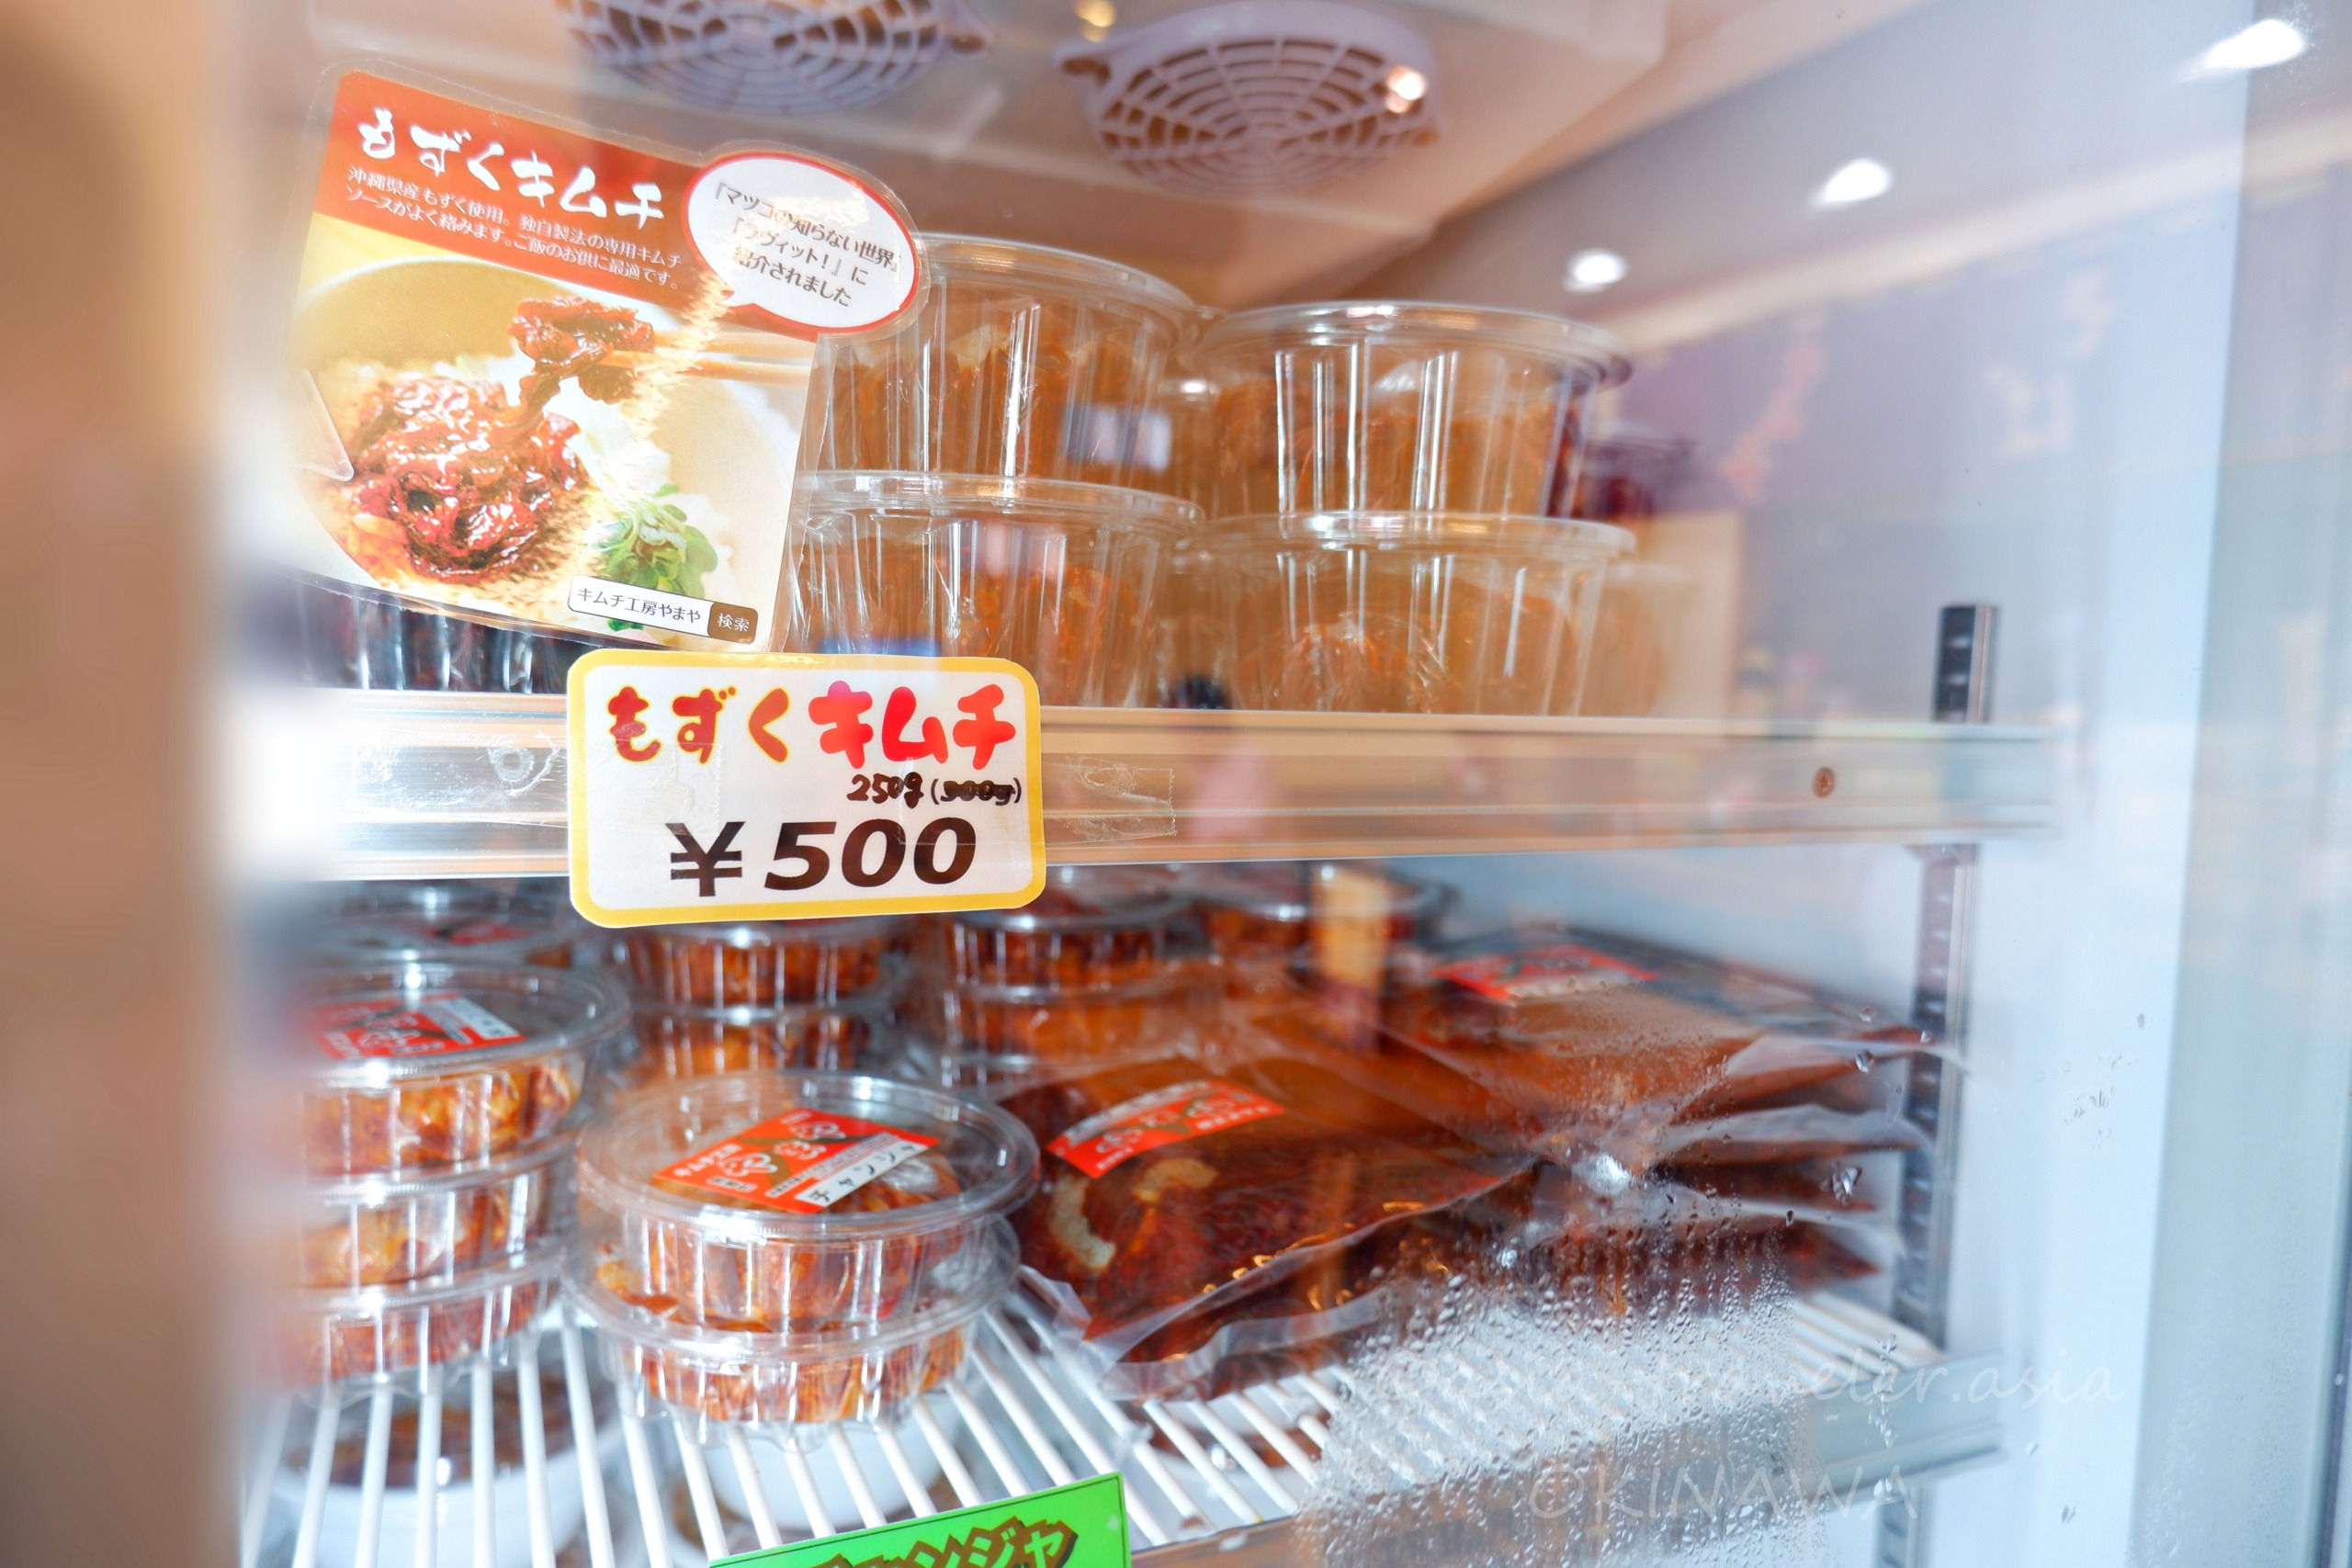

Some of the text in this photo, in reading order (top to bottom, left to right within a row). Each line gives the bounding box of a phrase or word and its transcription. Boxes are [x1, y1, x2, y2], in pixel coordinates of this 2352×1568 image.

[359, 108, 664, 229] もずくキムチ
[732, 244, 852, 308] 紹介されました
[577, 587, 702, 624] キムチ工房やまや
[717, 612, 752, 633] 検索
[606, 680, 1016, 770] もずくキムチ
[846, 772, 924, 808] 250g
[665, 817, 977, 897] ¥500
